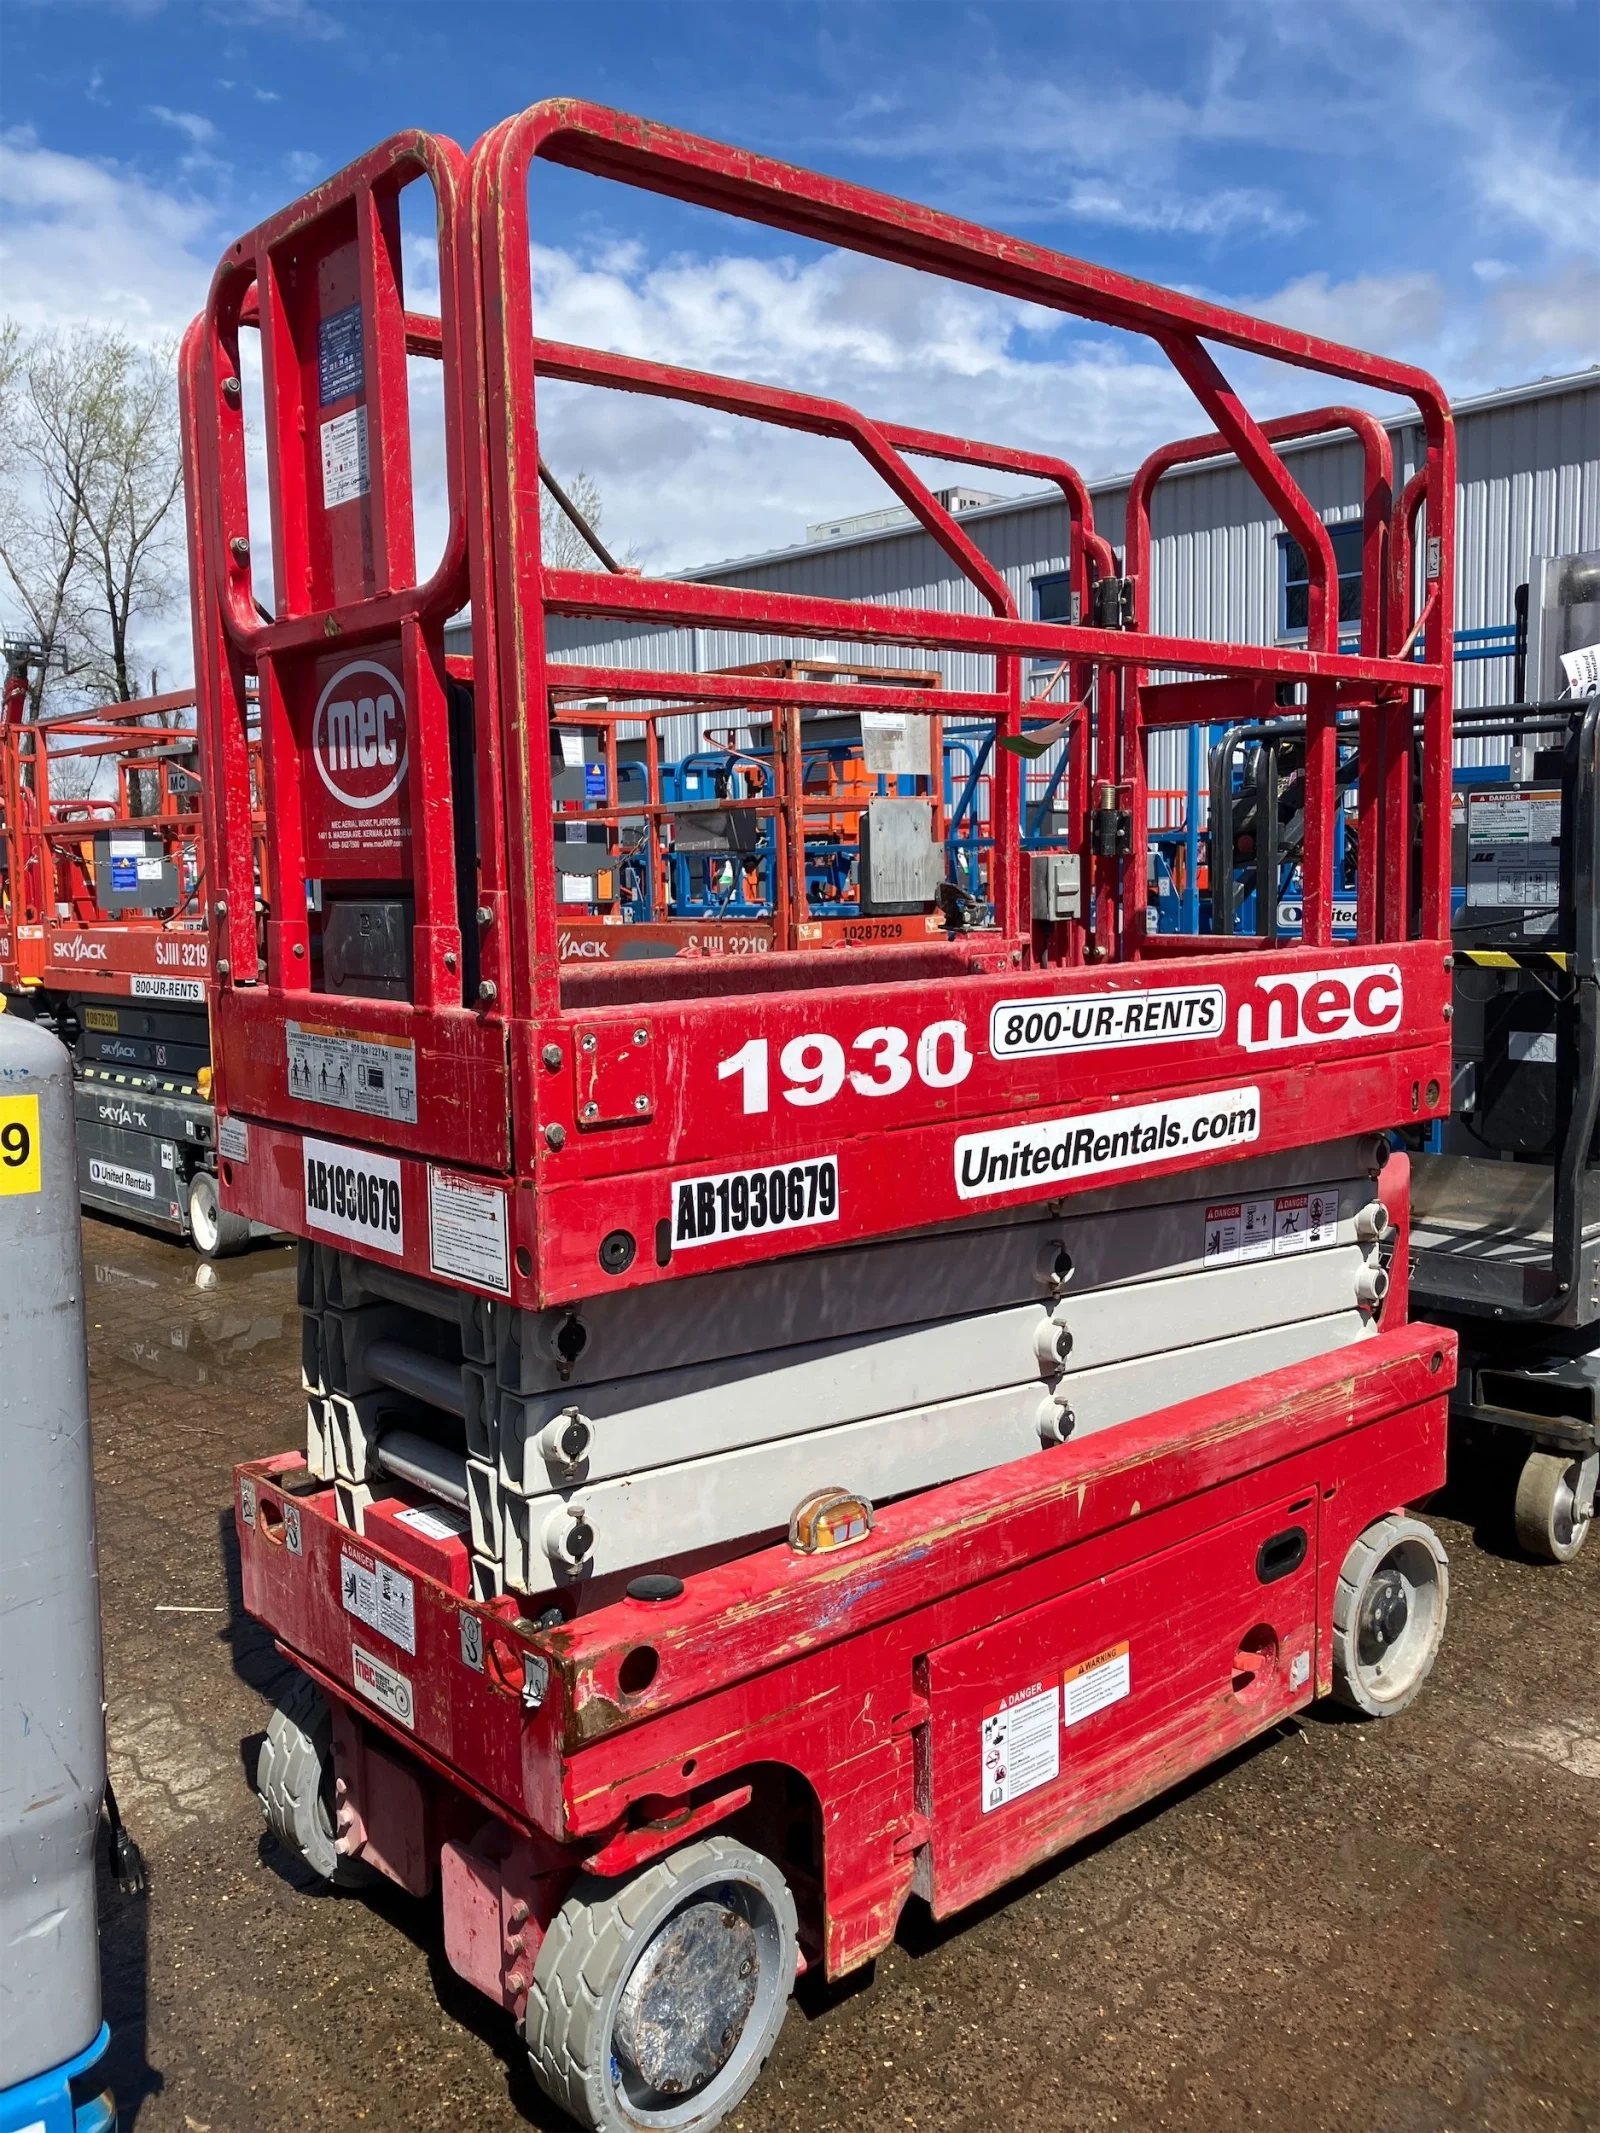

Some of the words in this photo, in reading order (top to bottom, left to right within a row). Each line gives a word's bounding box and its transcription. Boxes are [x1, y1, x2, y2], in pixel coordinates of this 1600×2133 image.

[1582, 654, 1593, 683] United
[170, 776, 186, 791] MC
[1489, 794, 1521, 802] DANGER
[842, 924, 903, 940] 10287829
[0, 938, 9, 957] 19
[53, 934, 108, 961] SKYJACK
[182, 943, 207, 968] 3219
[558, 932, 610, 960] JACK
[135, 979, 200, 999] 800-UR-RENTS
[1004, 997, 1217, 1047] 800-UR-RENTS
[101, 1040, 137, 1059] SKYJACK
[718, 1019, 974, 1115] 1930
[98, 1102, 147, 1128] SKYJAK
[962, 1107, 1257, 1188] UnitedRentals.com
[101, 1171, 125, 1186] United
[124, 1174, 152, 1192] Rentals
[307, 1158, 401, 1235] AB1930679
[676, 1162, 836, 1241] AB1930679
[1285, 1197, 1308, 1210] DANGER
[1214, 1206, 1240, 1218] DANGER
[350, 1546, 375, 1570] DANGER
[1085, 1648, 1117, 1671] WARNING
[1008, 1682, 1043, 1706] DANGER
